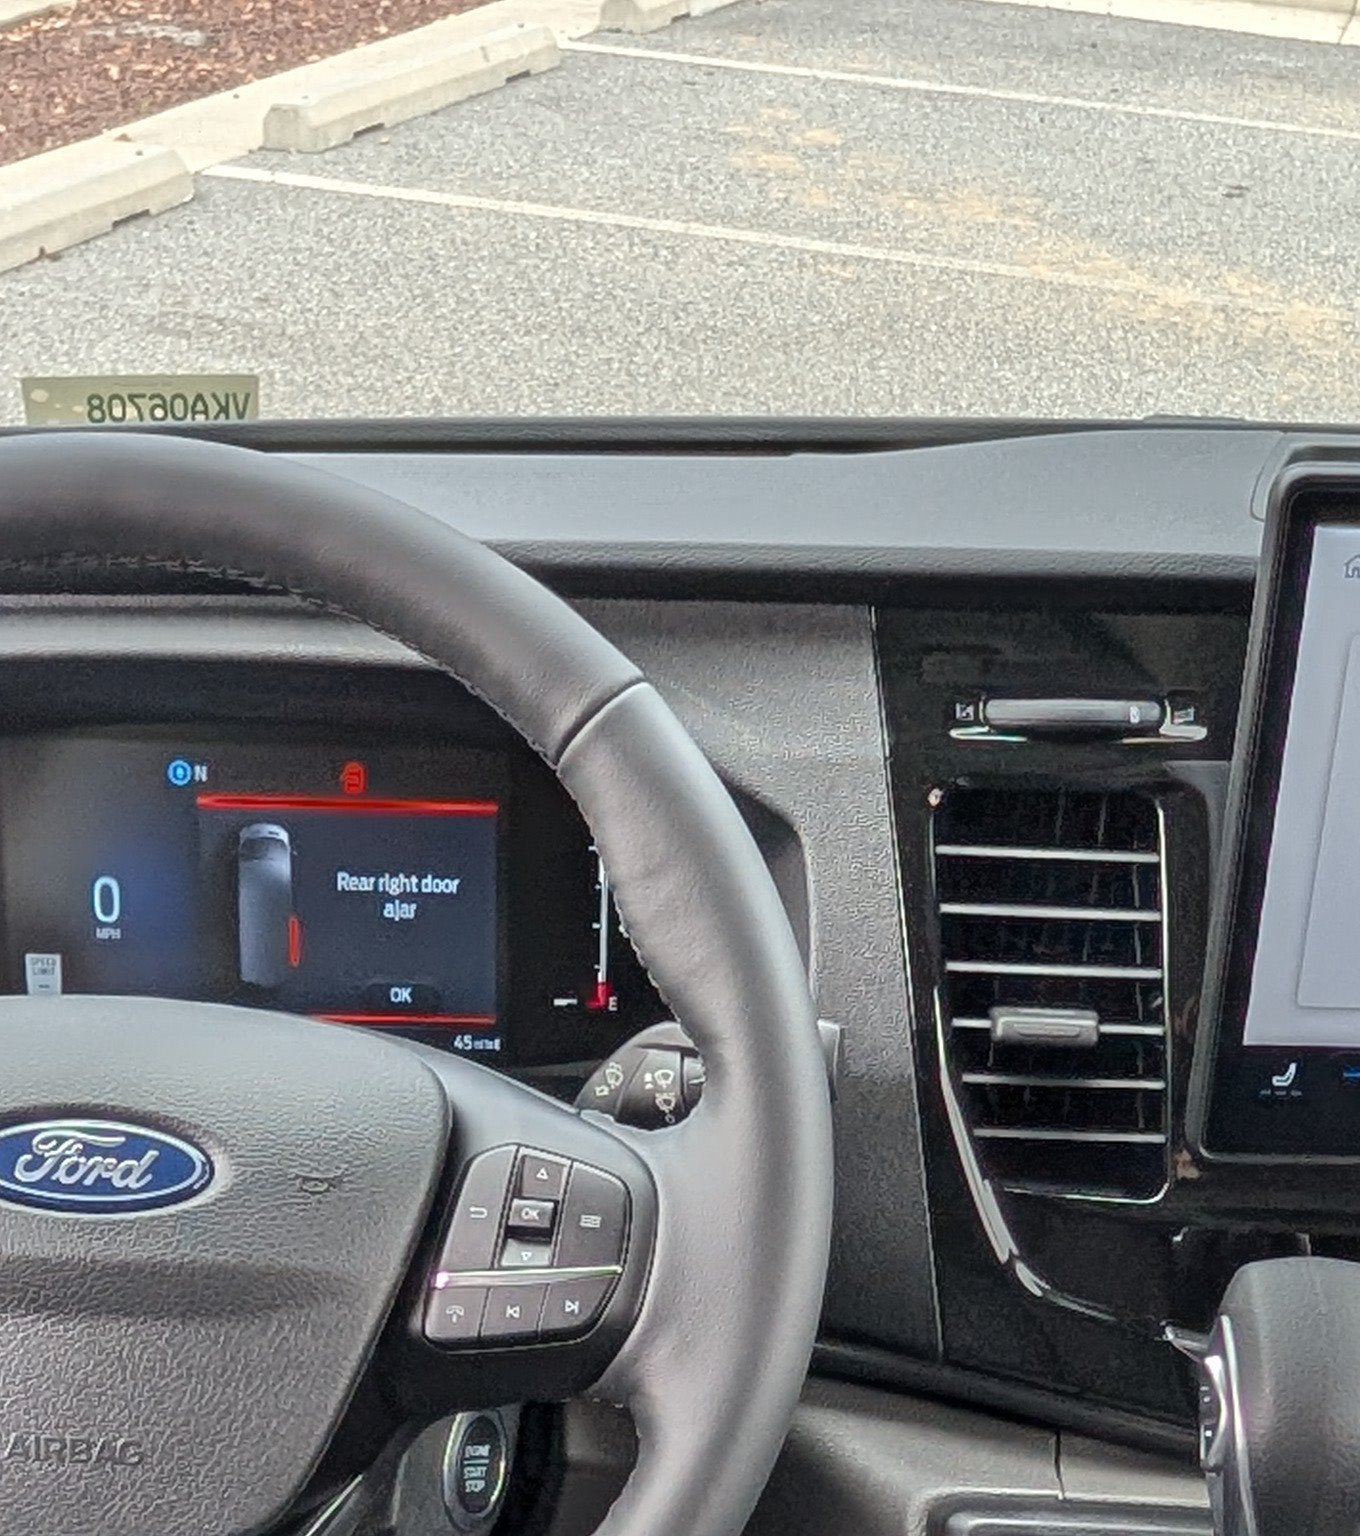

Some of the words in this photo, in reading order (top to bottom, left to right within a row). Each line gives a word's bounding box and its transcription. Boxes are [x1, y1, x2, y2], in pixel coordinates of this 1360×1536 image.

[194, 765, 208, 782] N
[337, 871, 375, 892] Rear
[378, 872, 418, 895] right
[421, 873, 460, 894] door
[93, 875, 120, 923] 0
[383, 900, 417, 921] ajar
[390, 987, 412, 1003] OK
[608, 997, 618, 1011] E
[453, 1035, 472, 1051] 45
[13, 1128, 159, 1191] Ford
[520, 1207, 540, 1221] OK
[2, 1431, 143, 1468] AIRBAG
